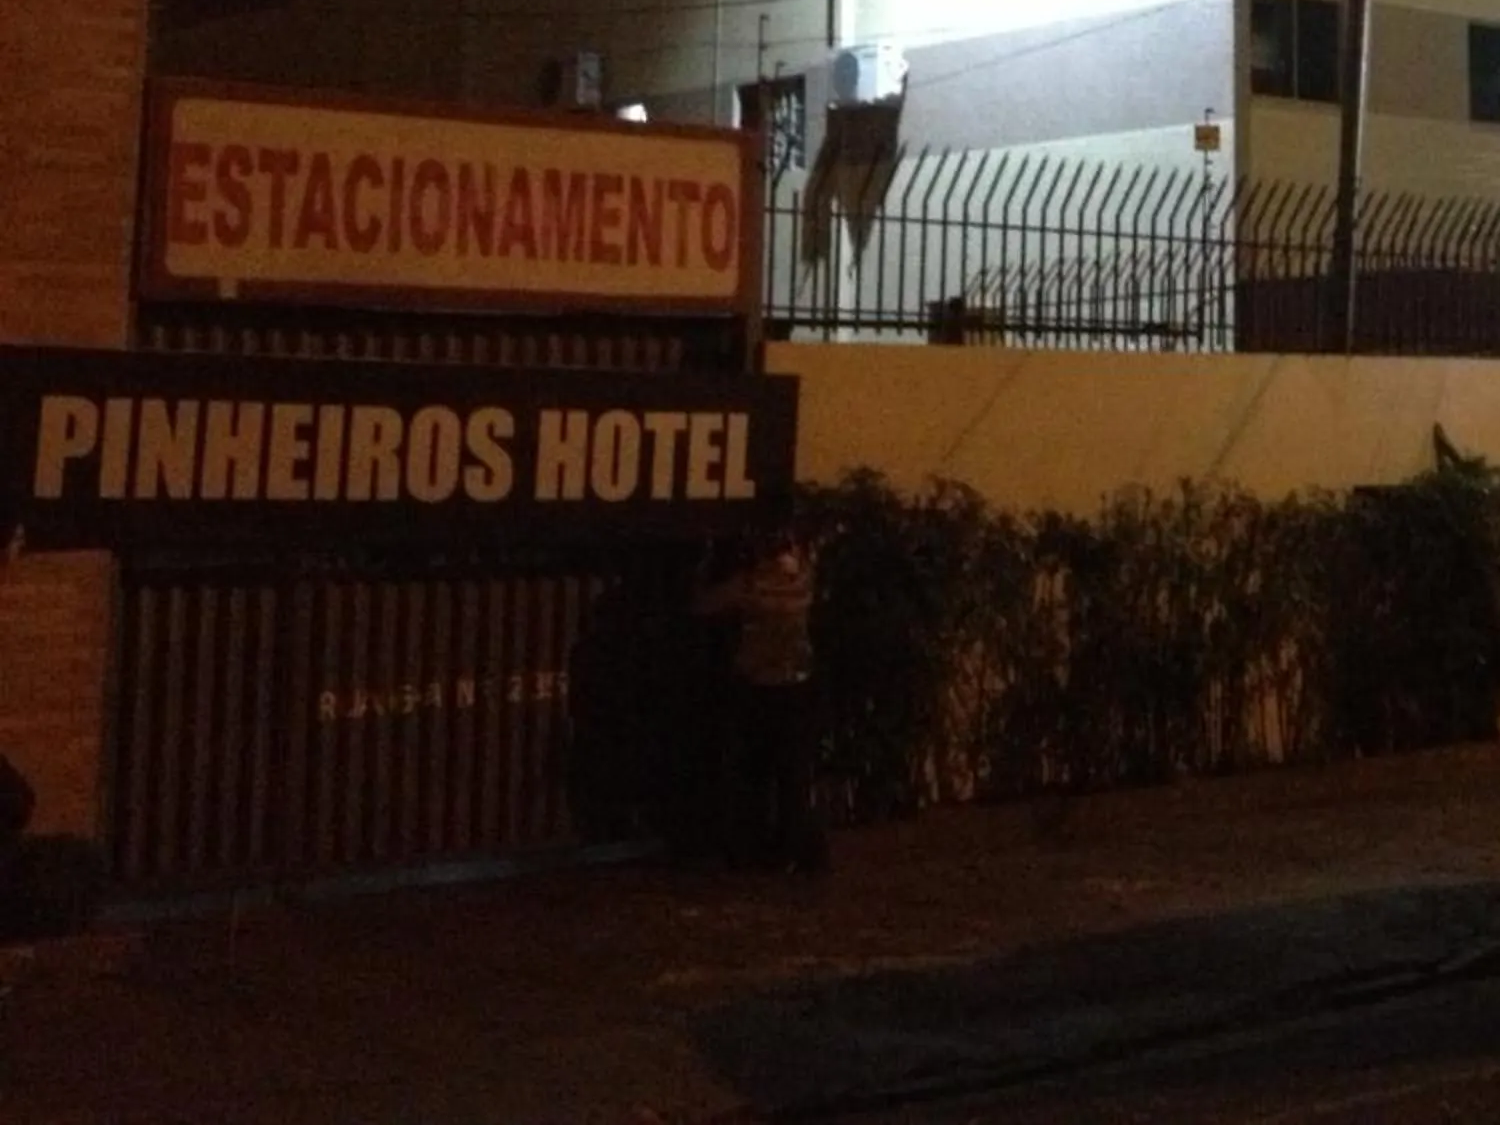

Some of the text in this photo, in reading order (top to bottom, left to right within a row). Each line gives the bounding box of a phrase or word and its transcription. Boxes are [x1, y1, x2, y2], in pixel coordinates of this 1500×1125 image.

[167, 142, 735, 272] ESTACIONAMENTO
[33, 394, 756, 504] PINHEIROS HOTEL
